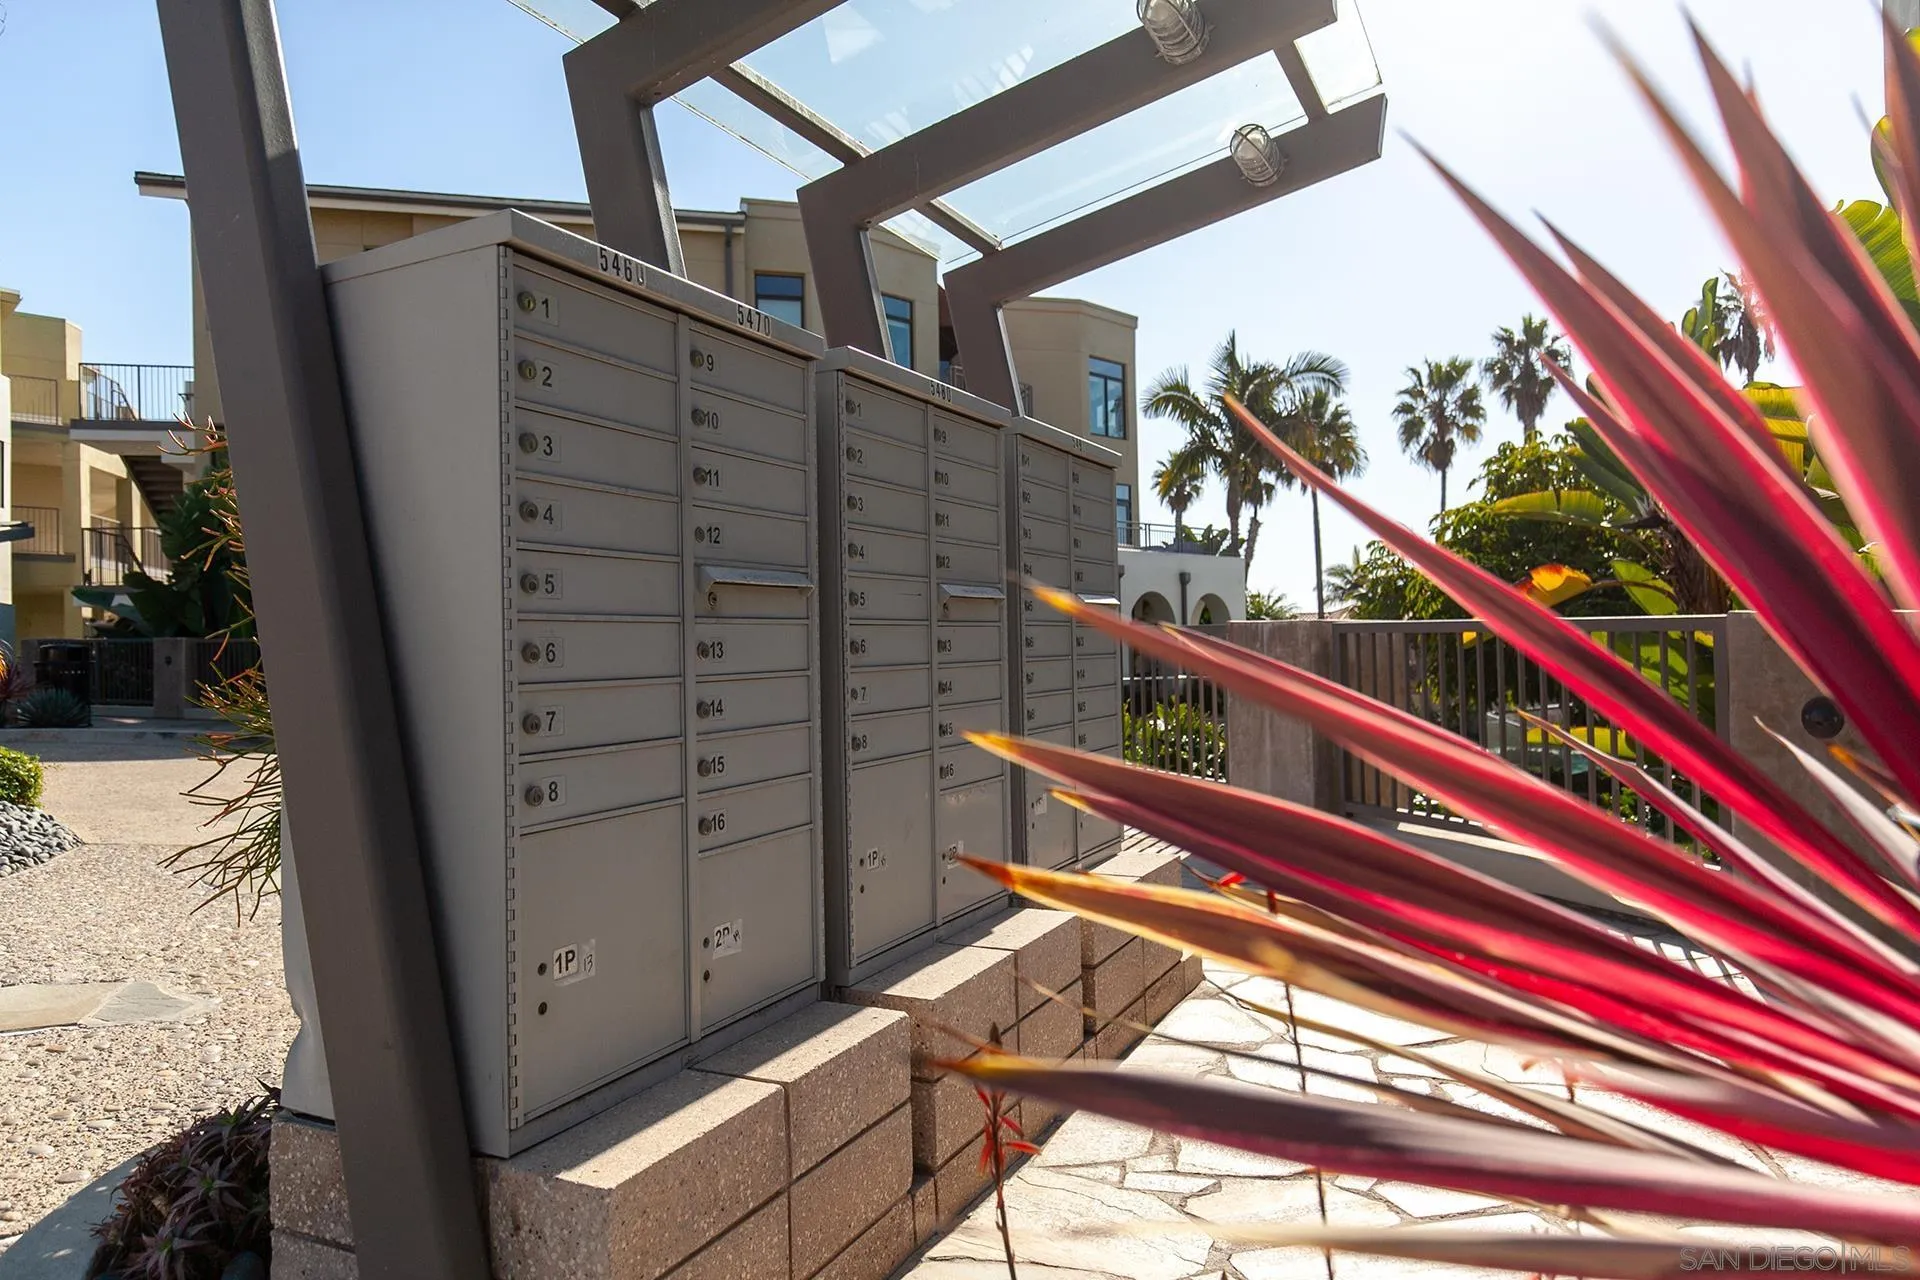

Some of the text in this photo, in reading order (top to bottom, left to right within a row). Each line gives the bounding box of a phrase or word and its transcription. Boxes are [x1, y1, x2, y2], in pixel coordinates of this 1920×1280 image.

[599, 249, 645, 286] 5460
[541, 298, 550, 318] 1
[737, 304, 771, 336] 5470
[706, 353, 714, 372] 9
[542, 367, 553, 388] 2
[856, 402, 862, 417] 1
[705, 412, 719, 430] 10
[543, 436, 554, 457] 3
[856, 450, 863, 464] 2
[706, 469, 720, 487] 11
[858, 497, 864, 511] 3
[542, 504, 554, 525] 4
[706, 526, 721, 544] 12
[858, 545, 865, 560] 4
[544, 574, 555, 595] 5
[859, 592, 866, 606] 5
[545, 642, 556, 663] 6
[709, 642, 724, 660] 13
[860, 639, 866, 653] 6
[861, 686, 867, 701] 7
[709, 699, 724, 717] 14
[546, 711, 556, 732] 7
[862, 735, 868, 749] 8
[710, 756, 725, 774] 15
[548, 781, 559, 802] 8
[711, 813, 726, 832] 16
[867, 850, 878, 867] 1P
[555, 949, 576, 974] 1P
